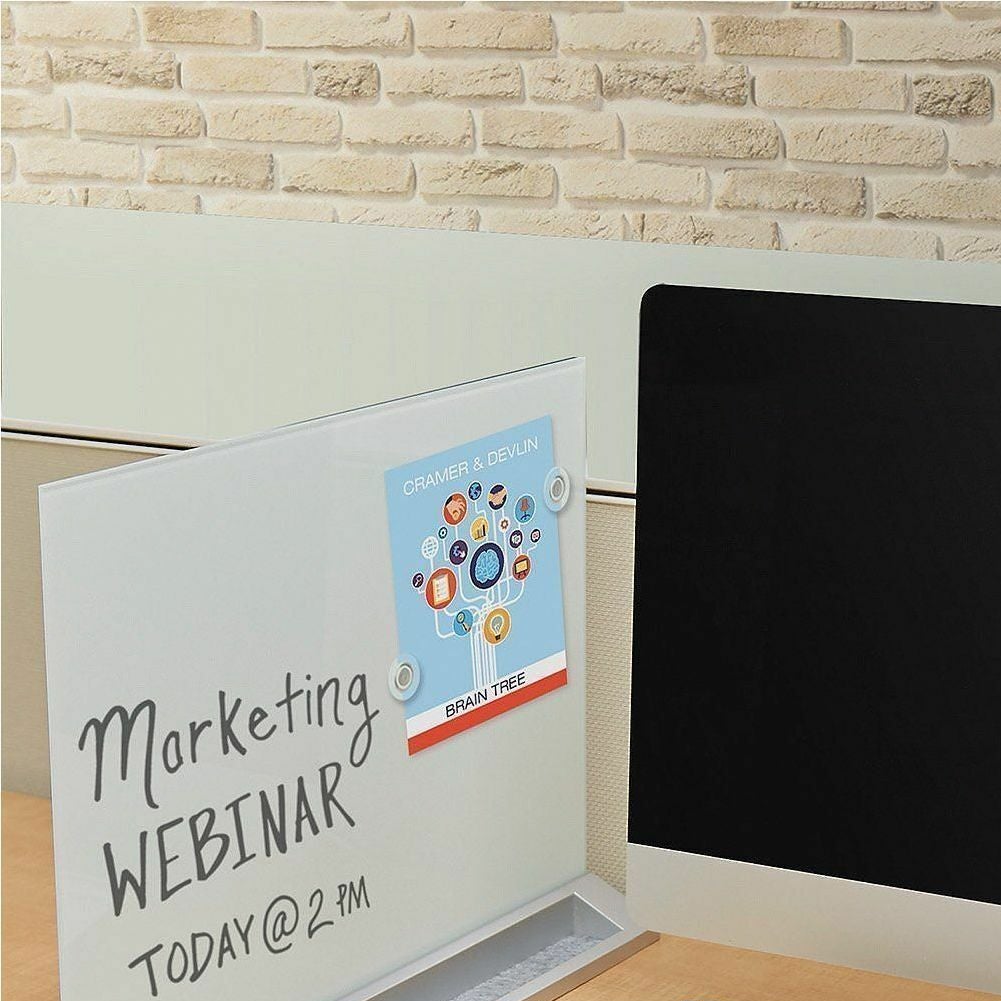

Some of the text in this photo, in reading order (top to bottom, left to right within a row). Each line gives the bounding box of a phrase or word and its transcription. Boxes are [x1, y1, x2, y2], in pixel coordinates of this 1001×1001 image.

[403, 435, 539, 496] CRAMER & DEVLIN
[78, 672, 379, 809] Marketing
[445, 672, 527, 718] BRAIN TREE
[103, 762, 355, 916] WEBINAR
